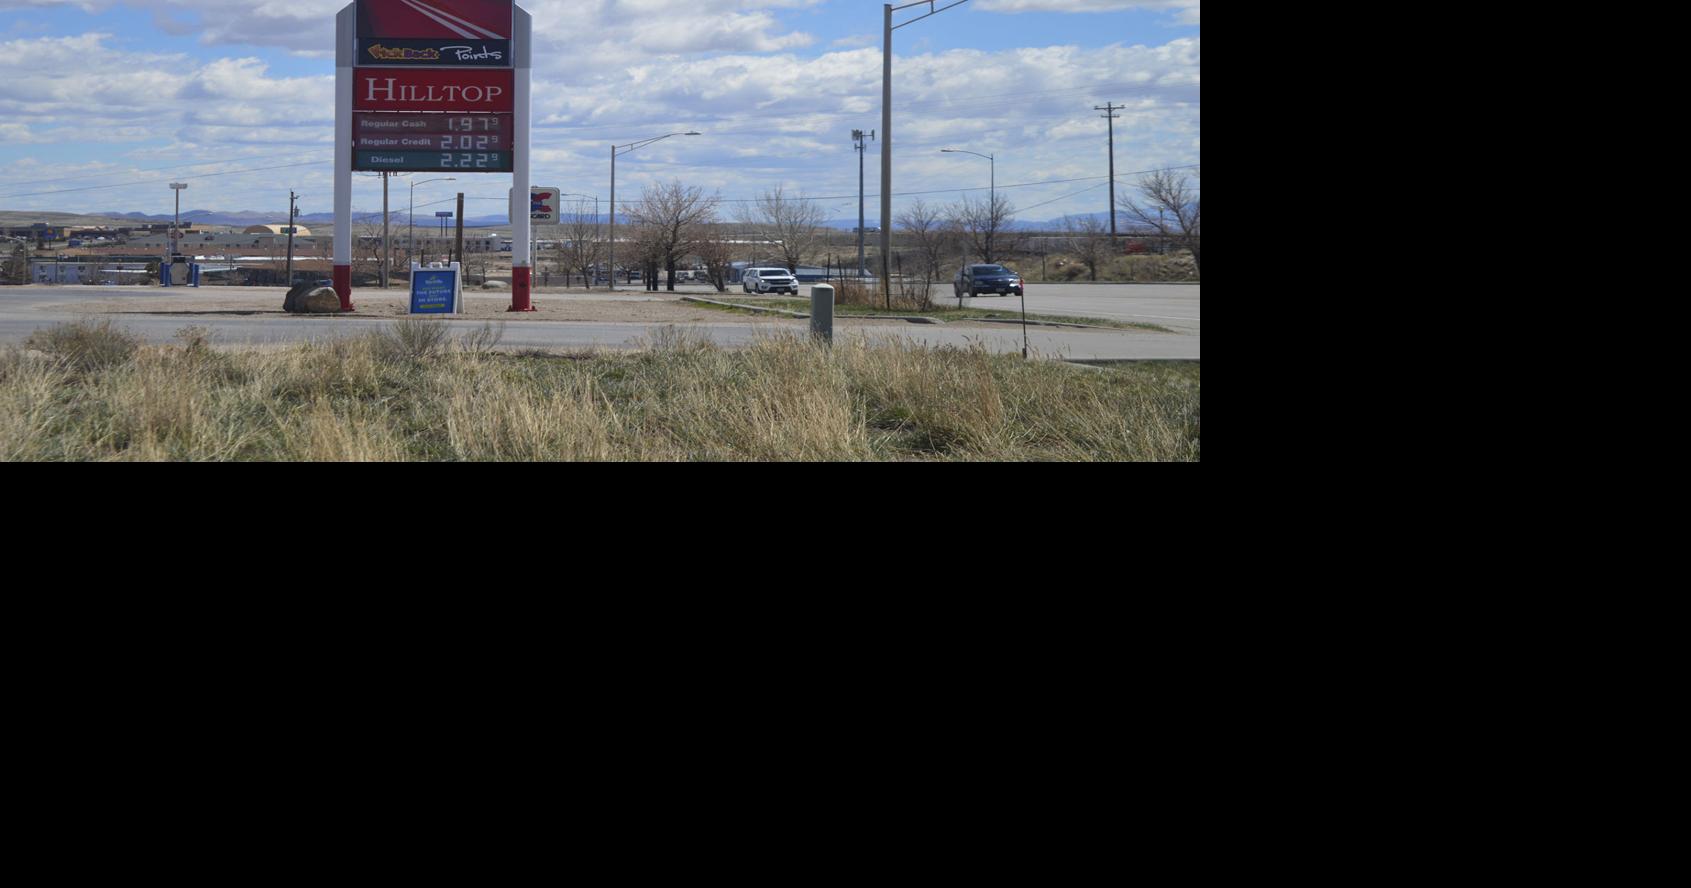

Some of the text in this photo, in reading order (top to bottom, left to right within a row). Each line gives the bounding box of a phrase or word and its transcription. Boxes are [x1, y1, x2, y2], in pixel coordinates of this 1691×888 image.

[440, 46, 502, 61] Points
[360, 120, 399, 129] Regular
[401, 119, 427, 128] Cash
[360, 138, 399, 147] Regular
[401, 138, 432, 146] Credit
[370, 156, 404, 164] Diesel
